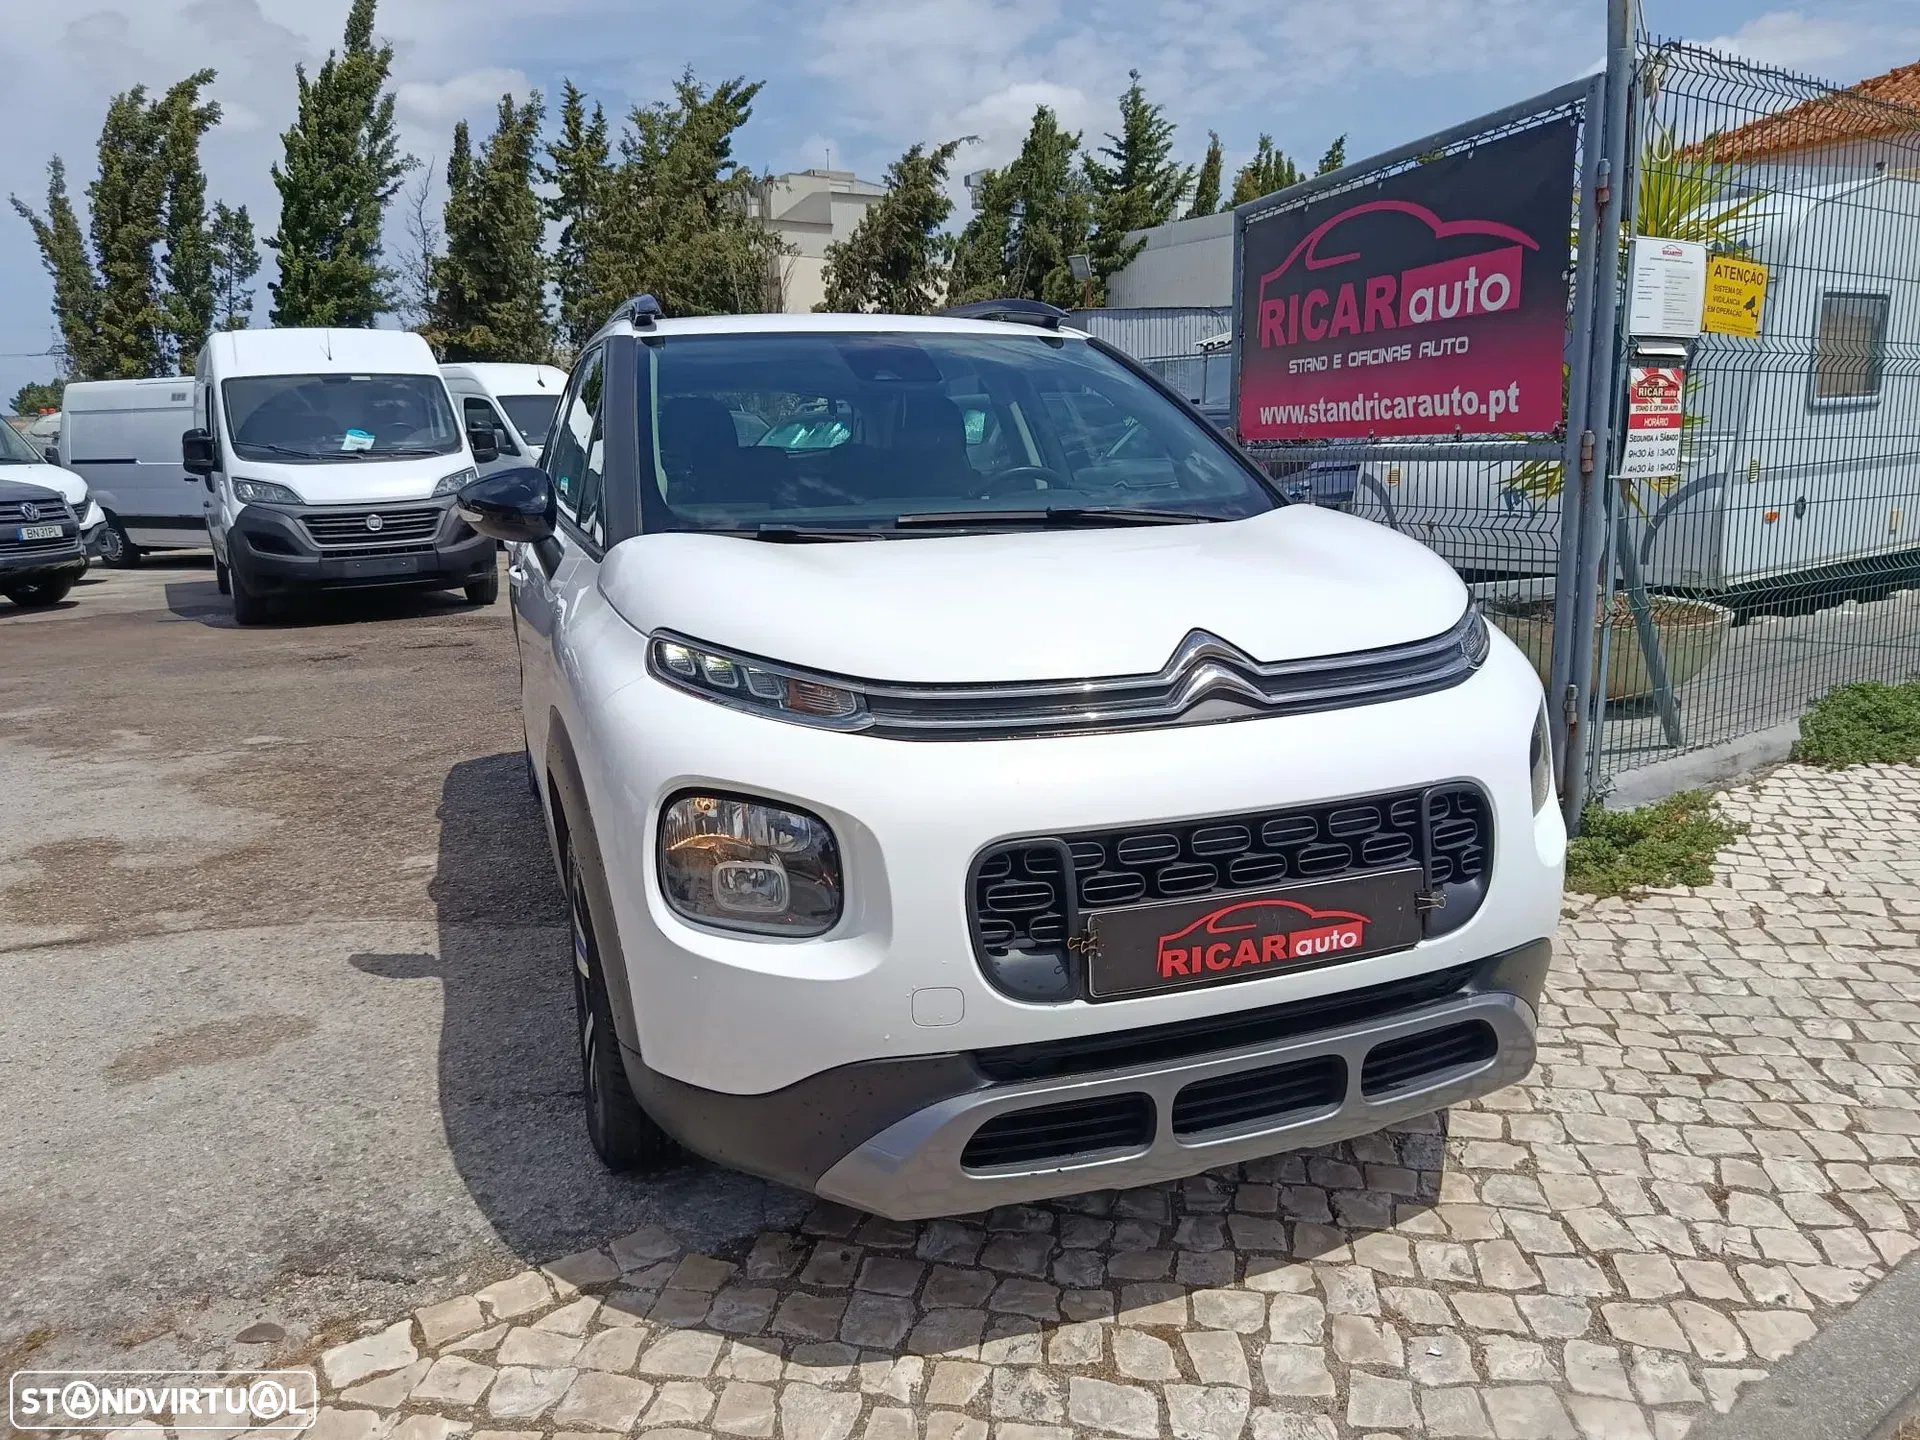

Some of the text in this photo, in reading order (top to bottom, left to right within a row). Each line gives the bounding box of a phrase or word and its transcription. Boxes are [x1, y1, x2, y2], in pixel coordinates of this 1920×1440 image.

[1713, 264, 1764, 286] ATENÇÃO
[1713, 284, 1743, 296] SISTEMA DE
[1261, 266, 1511, 349] RICAR auto
[1707, 305, 1716, 313] EM
[1712, 295, 1740, 306] VIGILÂNCIA
[1288, 336, 1469, 374] STAND E OFICINAS AUTO
[1260, 380, 1520, 426] www.standricarauto.pt
[1643, 415, 1669, 427] HORÁRIO
[26, 527, 59, 539] BN31PL
[1162, 928, 1358, 978] RICAR auto
